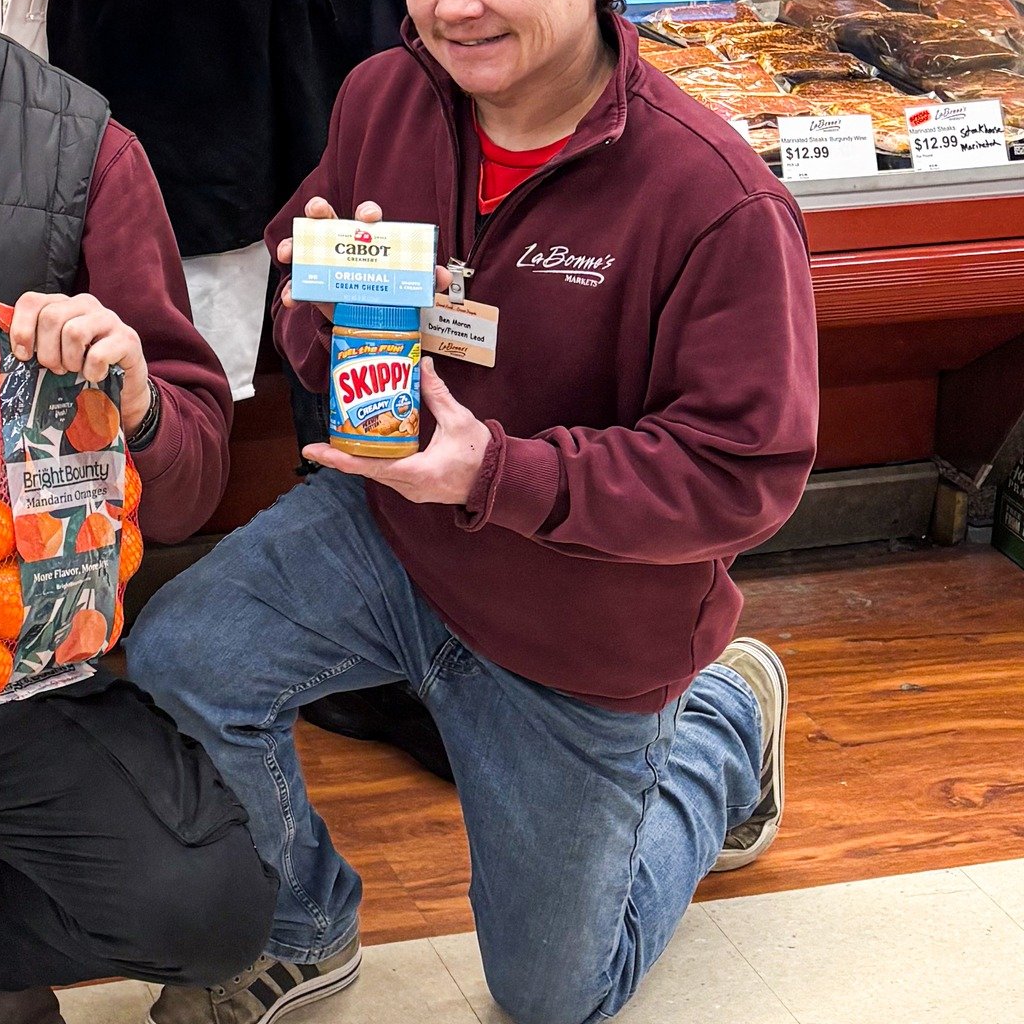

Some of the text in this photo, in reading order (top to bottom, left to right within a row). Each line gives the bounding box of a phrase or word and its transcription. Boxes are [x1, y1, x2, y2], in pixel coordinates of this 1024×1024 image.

[909, 125, 956, 134] Marinated Steaks
[781, 136, 808, 144] Marinated
[829, 136, 854, 144] Burgundy
[915, 135, 958, 151] $12.99
[785, 146, 830, 160] $12.99
[516, 243, 616, 270] LaBonne's
[335, 271, 389, 283] ORIGINAL
[564, 274, 598, 287] MARKETS
[335, 282, 388, 292] CREAM CHEESE
[439, 315, 450, 324] Ben
[428, 322, 485, 342] Dairy/Frozen Lead
[338, 348, 358, 360] FUEL
[339, 362, 411, 403] SKIPPY
[357, 400, 389, 419] CREAMY
[23, 461, 109, 490] BrightBounty
[27, 487, 108, 509] Mandarin Oranges
[33, 572, 53, 583] More
[81, 562, 99, 574] More
